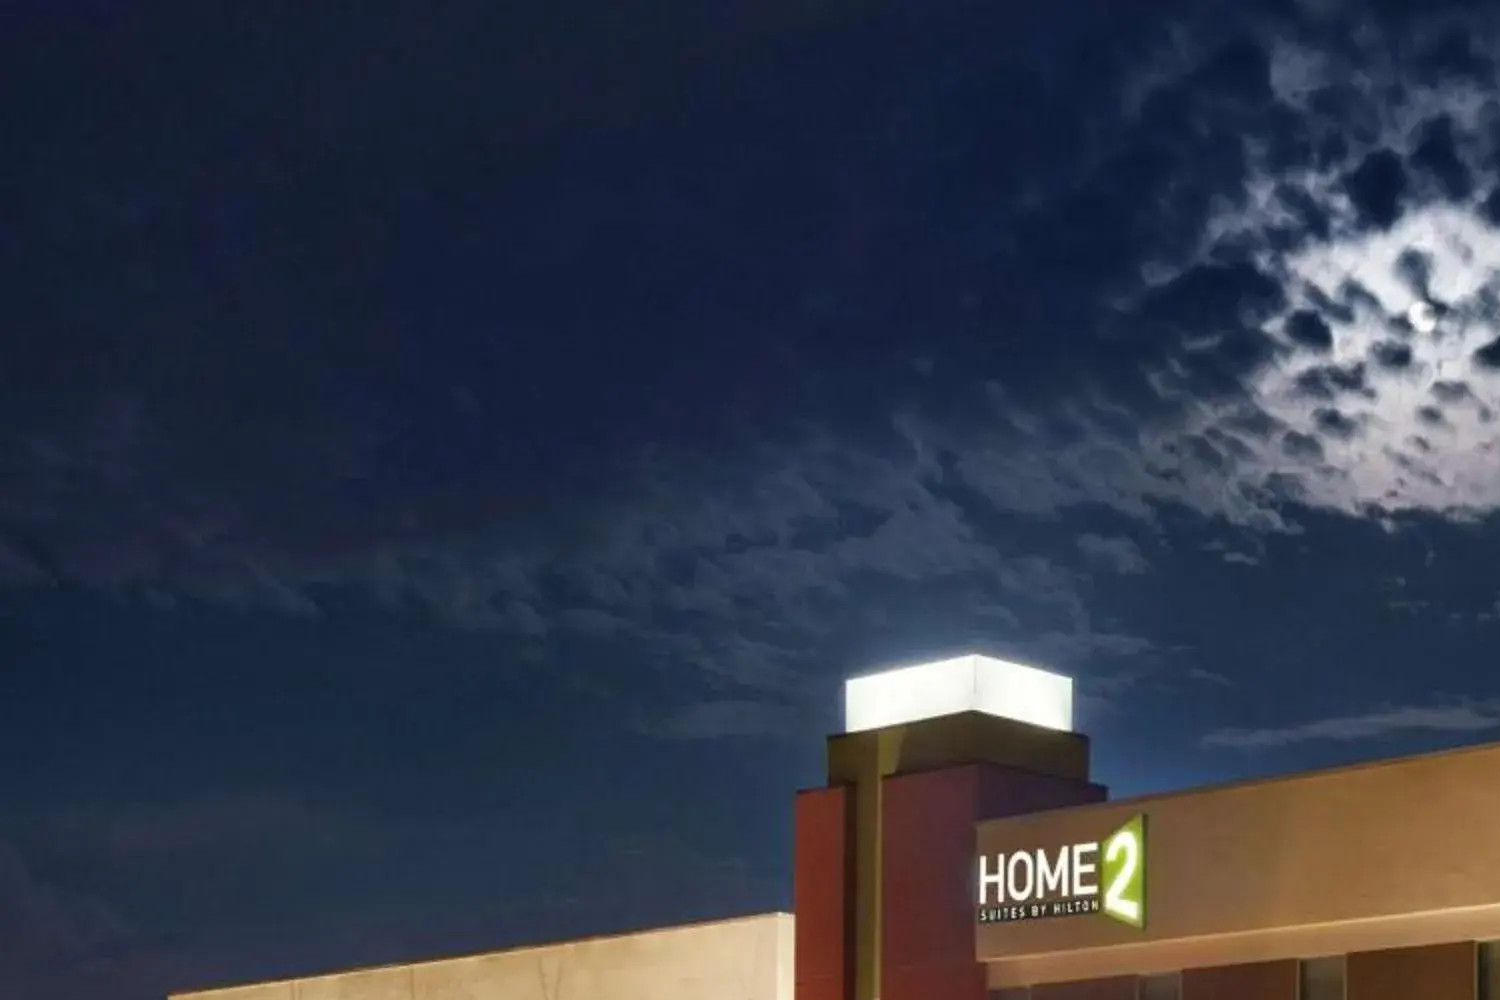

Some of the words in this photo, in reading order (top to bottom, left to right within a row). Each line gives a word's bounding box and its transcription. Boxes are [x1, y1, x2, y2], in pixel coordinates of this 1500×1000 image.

[980, 907, 1025, 921] SUITES
[1031, 904, 1046, 917] BY
[1053, 899, 1099, 914] HILTON
